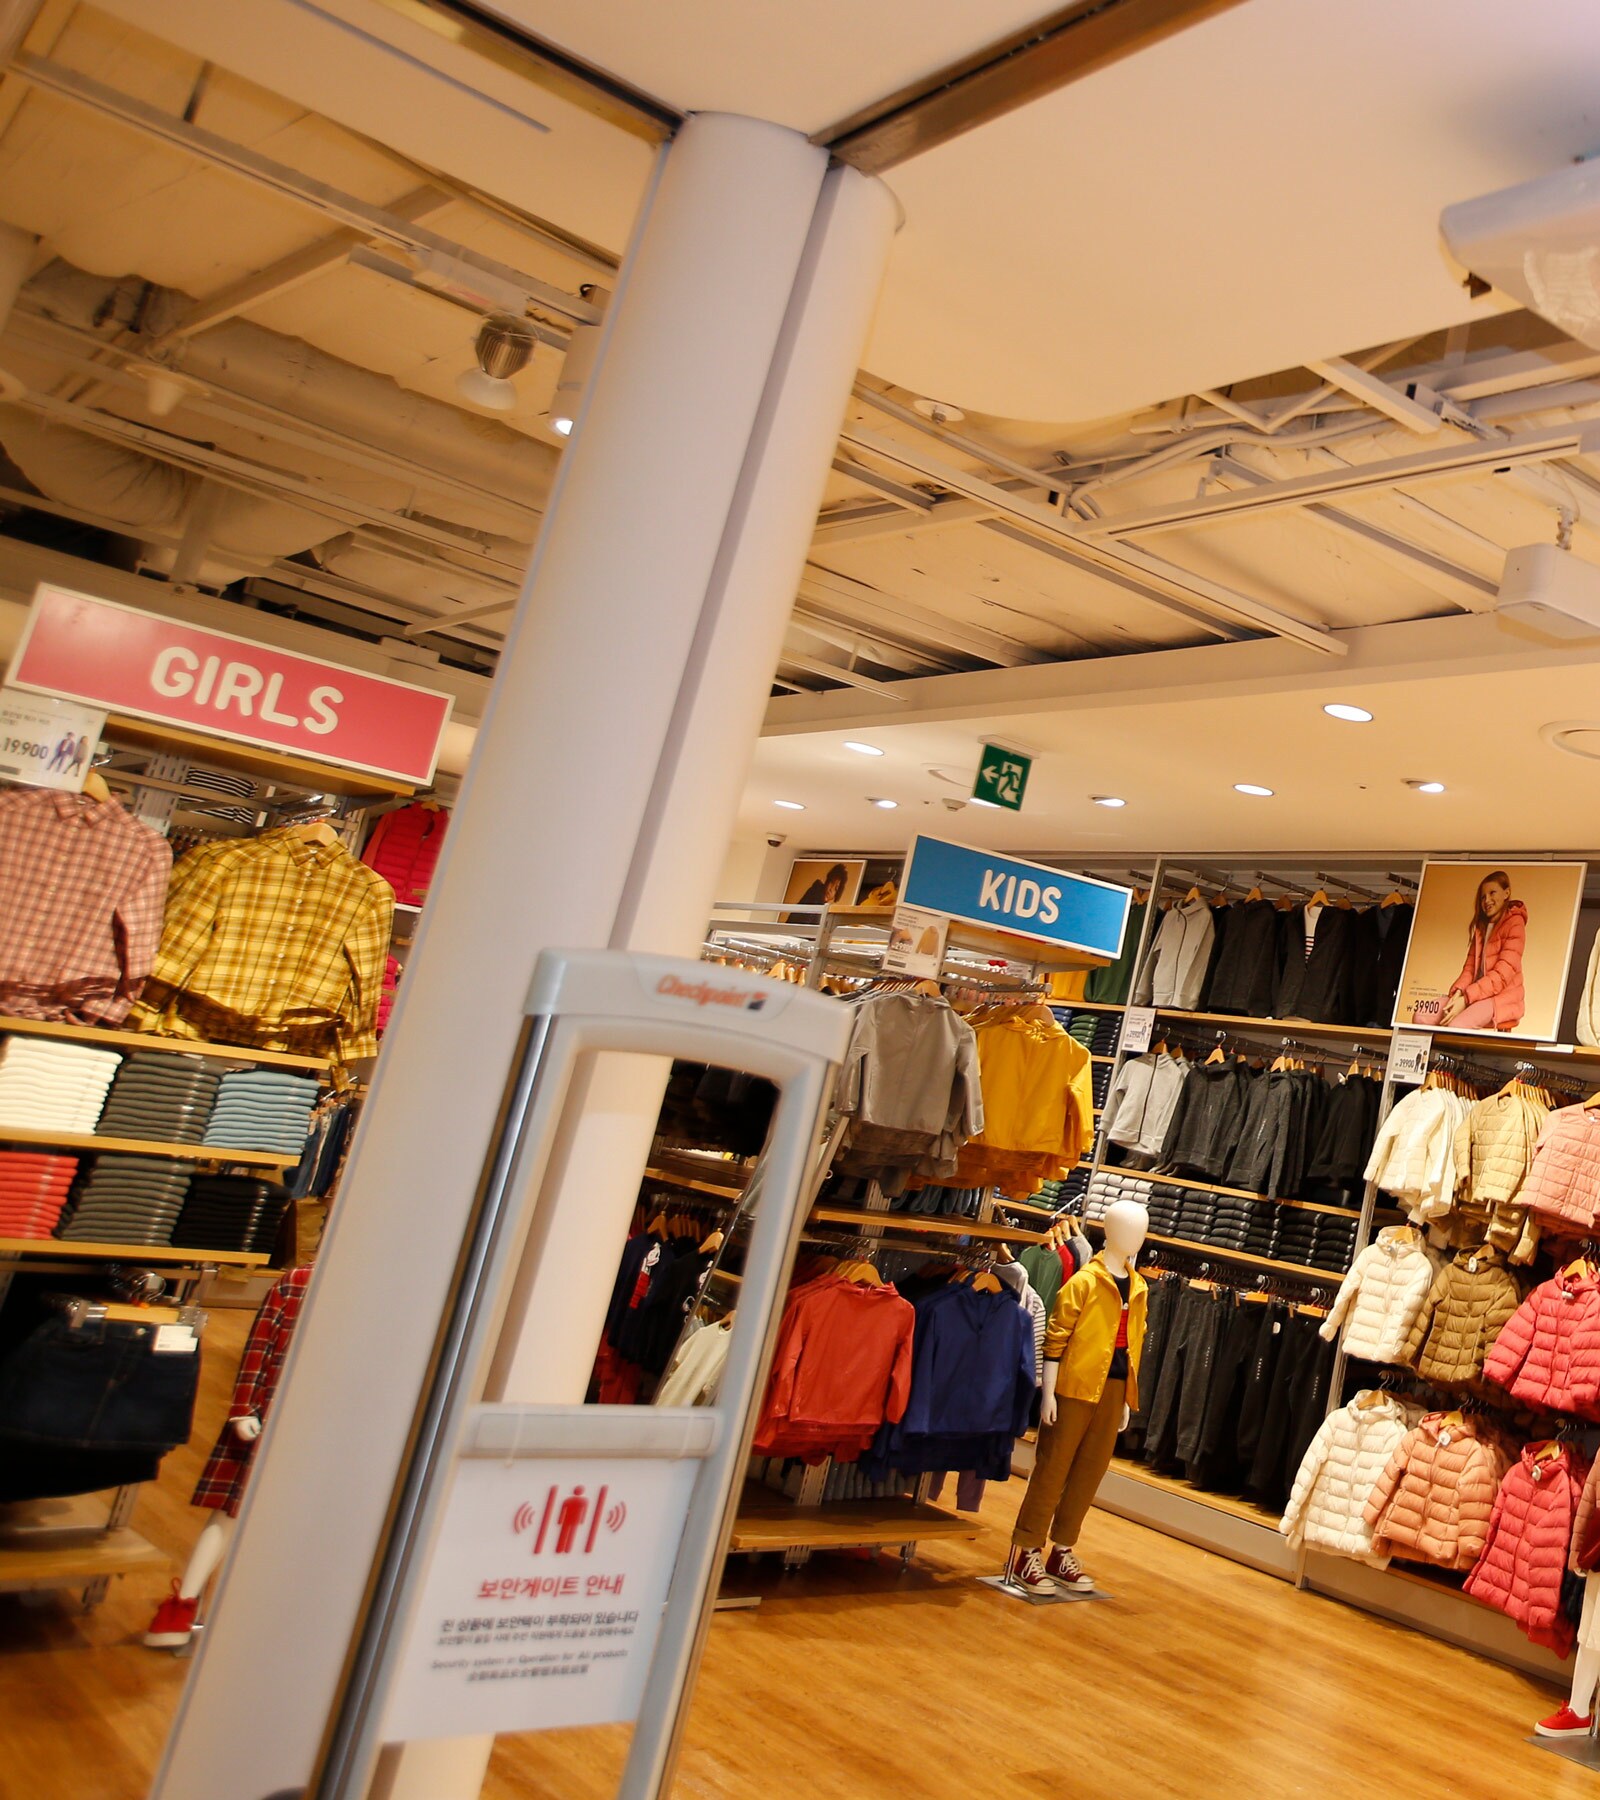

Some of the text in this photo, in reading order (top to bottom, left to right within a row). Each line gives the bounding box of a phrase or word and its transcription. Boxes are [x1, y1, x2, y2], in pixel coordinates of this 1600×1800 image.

[151, 646, 345, 735] GIRLS
[979, 869, 1062, 924] KIDS
[477, 1573, 626, 1600] 보안게이트 안내
